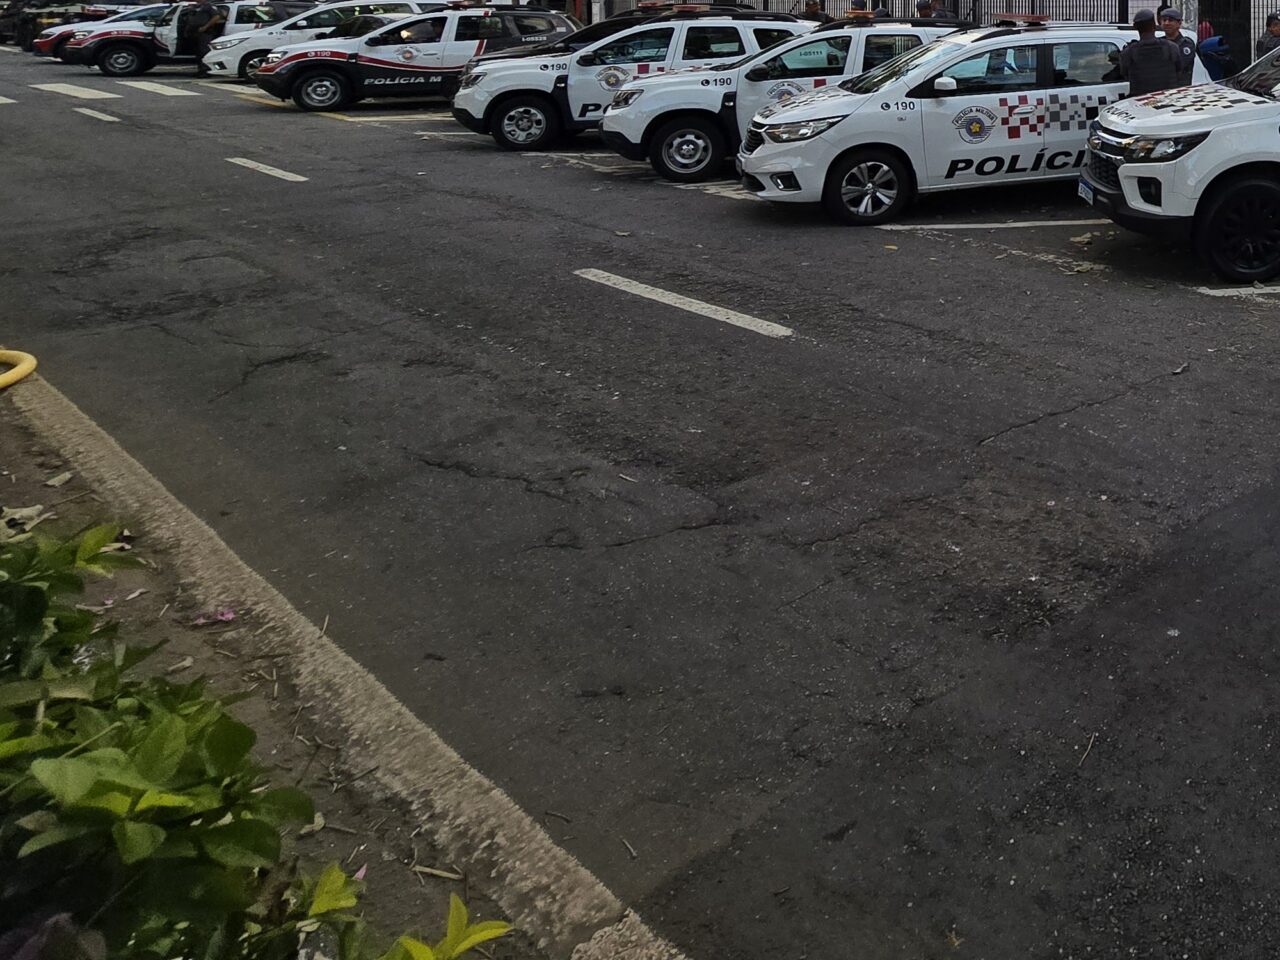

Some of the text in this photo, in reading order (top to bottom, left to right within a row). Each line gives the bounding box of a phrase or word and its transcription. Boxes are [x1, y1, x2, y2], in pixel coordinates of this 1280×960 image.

[550, 63, 567, 71] 190
[364, 75, 425, 85] POLÍCIA
[713, 77, 732, 86] 190
[893, 101, 916, 111] 190
[955, 107, 995, 123] POLÍCIA MILITAR
[944, 147, 1089, 180] POLÍCI
